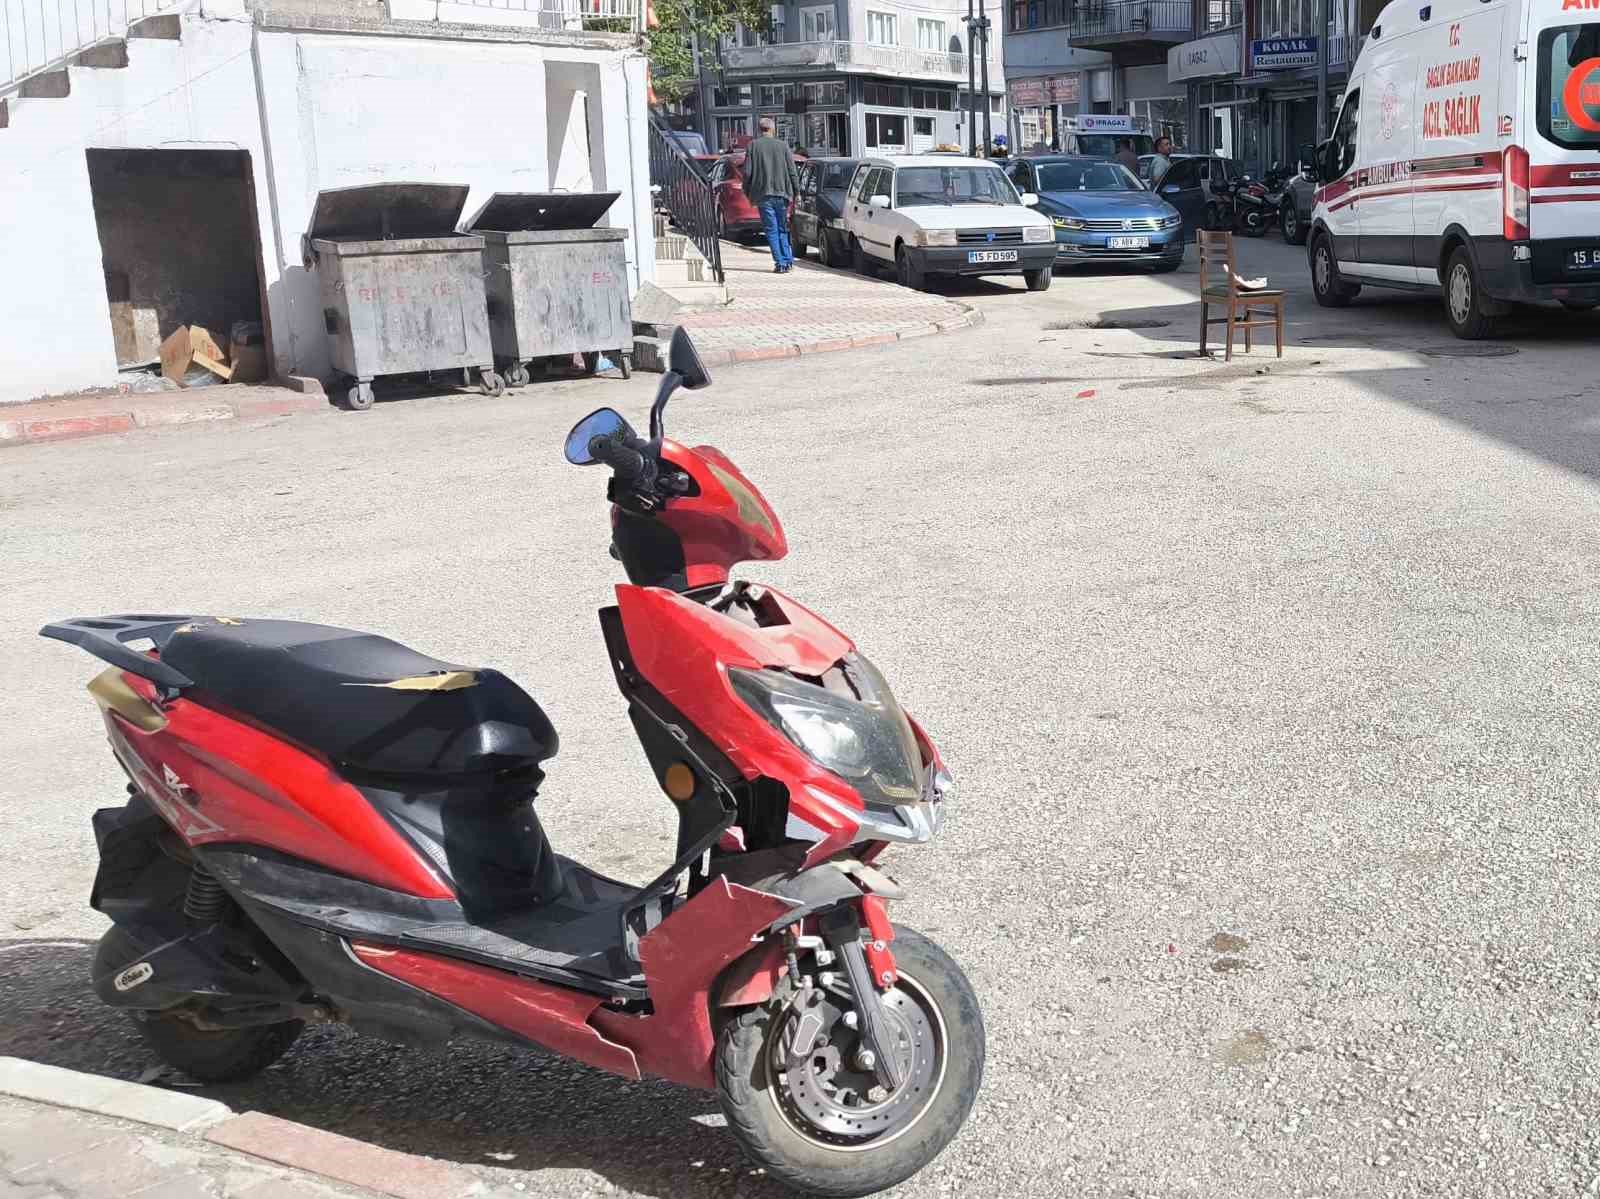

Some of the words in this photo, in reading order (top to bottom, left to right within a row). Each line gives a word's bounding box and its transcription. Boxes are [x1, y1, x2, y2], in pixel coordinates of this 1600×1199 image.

[1262, 39, 1308, 52] KONAK
[1256, 54, 1314, 66] Restaurant
[1444, 91, 1481, 137] SAĞLIK
[1367, 161, 1410, 185] AMBULANS
[976, 253, 985, 261] 15
[986, 252, 999, 261] FD
[1573, 250, 1587, 264] 15
